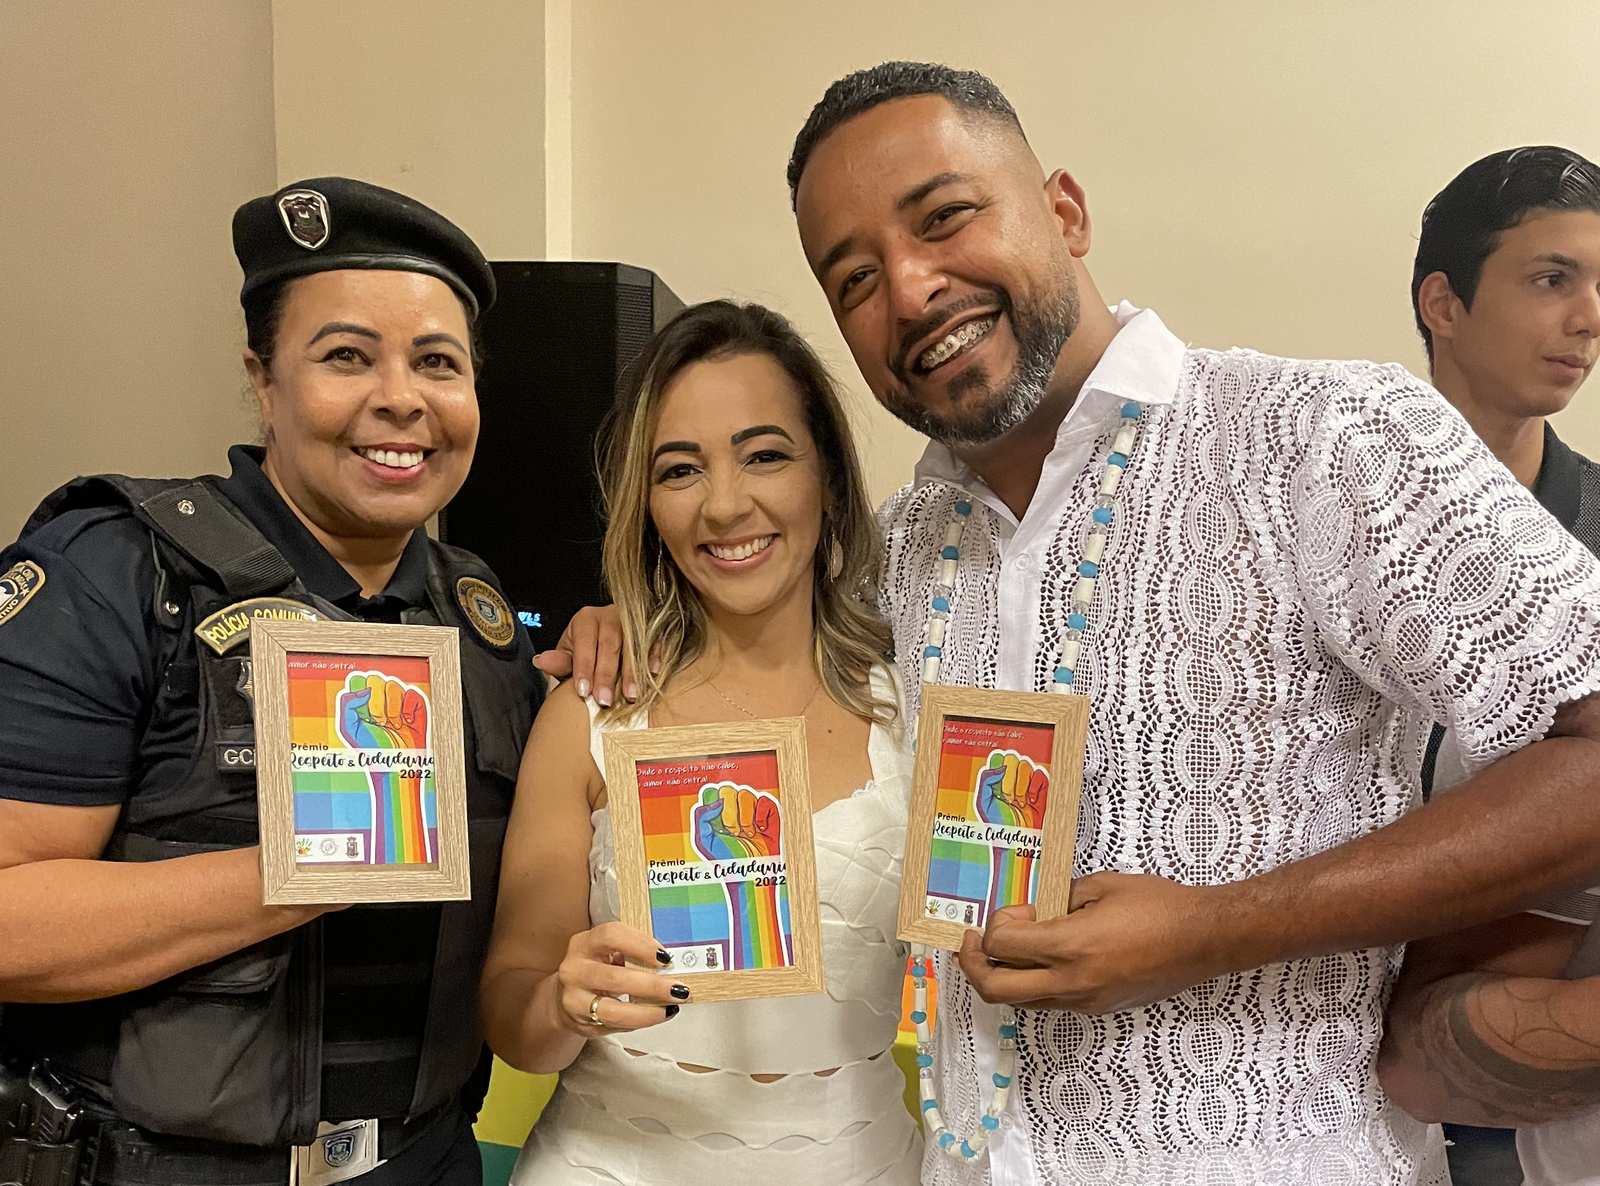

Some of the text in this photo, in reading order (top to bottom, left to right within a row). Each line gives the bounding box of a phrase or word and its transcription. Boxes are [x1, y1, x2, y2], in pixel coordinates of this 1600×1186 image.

[204, 612, 250, 645] POLÍCIA
[287, 661, 310, 669] amor
[312, 660, 327, 669] não
[291, 742, 329, 751] Prêmio
[223, 748, 257, 766] GC
[347, 759, 356, 767] &
[664, 764, 699, 775] respeito
[701, 762, 716, 771] não
[717, 760, 739, 770] cabe,
[400, 768, 432, 779] 2022
[643, 780, 664, 788] amor
[666, 777, 681, 785] não
[937, 812, 966, 822] Prêmio
[932, 820, 976, 840] Respeito
[976, 832, 983, 840] &
[1016, 847, 1042, 860] 2022
[650, 857, 686, 868] Prêmio
[647, 866, 702, 886] Respeito
[704, 871, 712, 880] &
[755, 875, 787, 887] 2022
